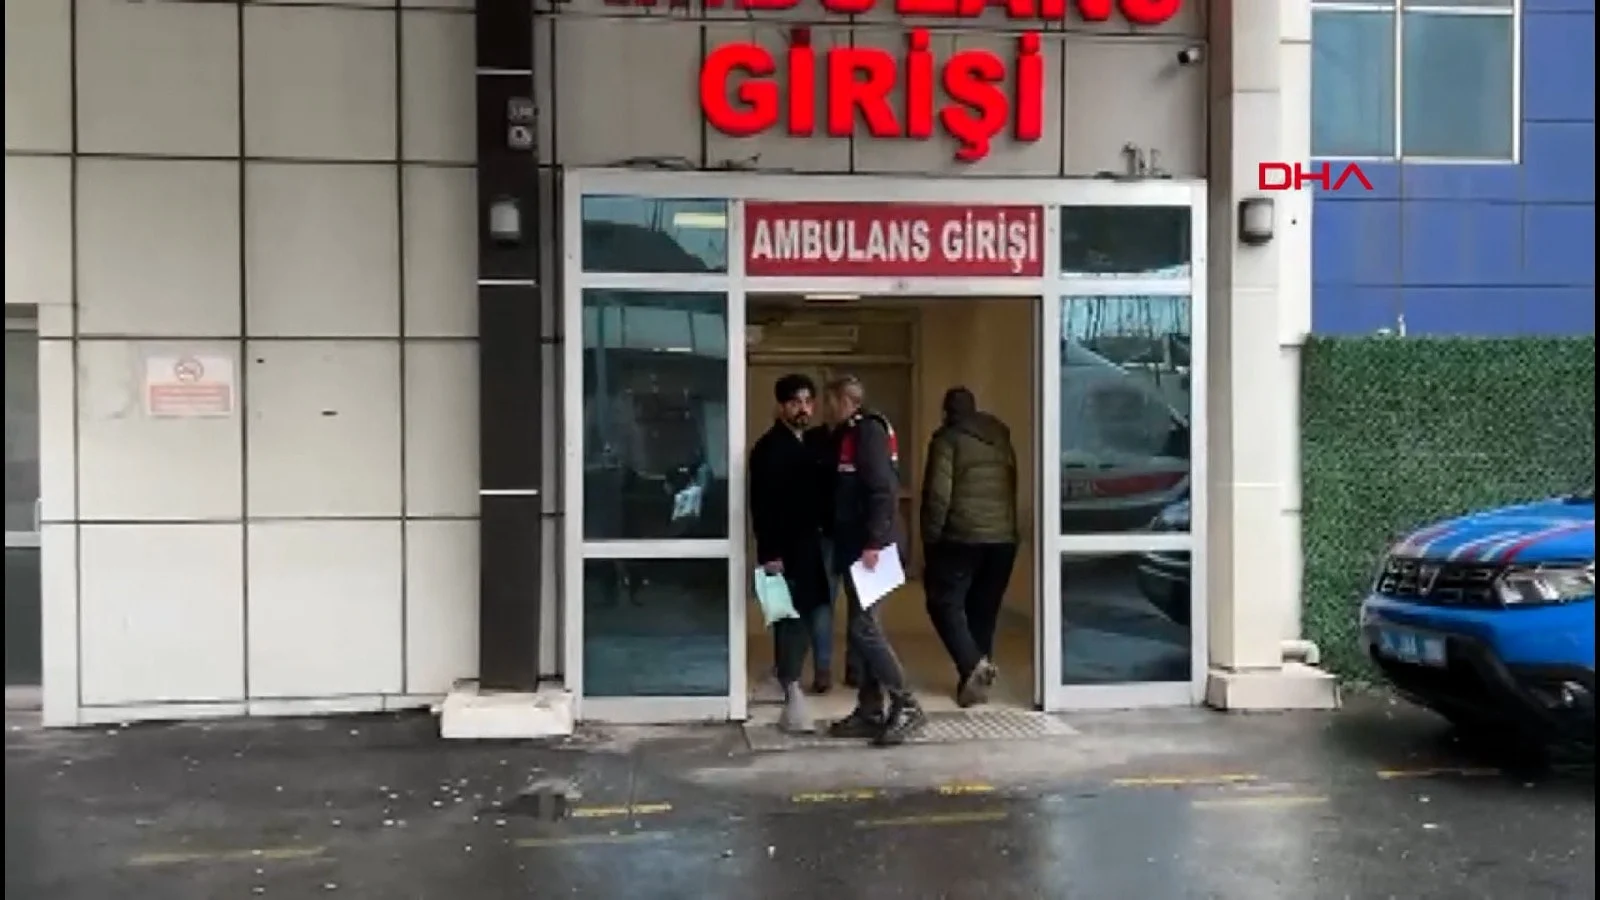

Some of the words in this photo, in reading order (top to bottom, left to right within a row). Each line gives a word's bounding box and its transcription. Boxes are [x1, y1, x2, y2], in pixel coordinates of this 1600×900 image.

[700, 25, 1046, 160] GİRİŞİ
[751, 219, 930, 261] AMBULANS
[941, 210, 1037, 273] GİRİŞİ
